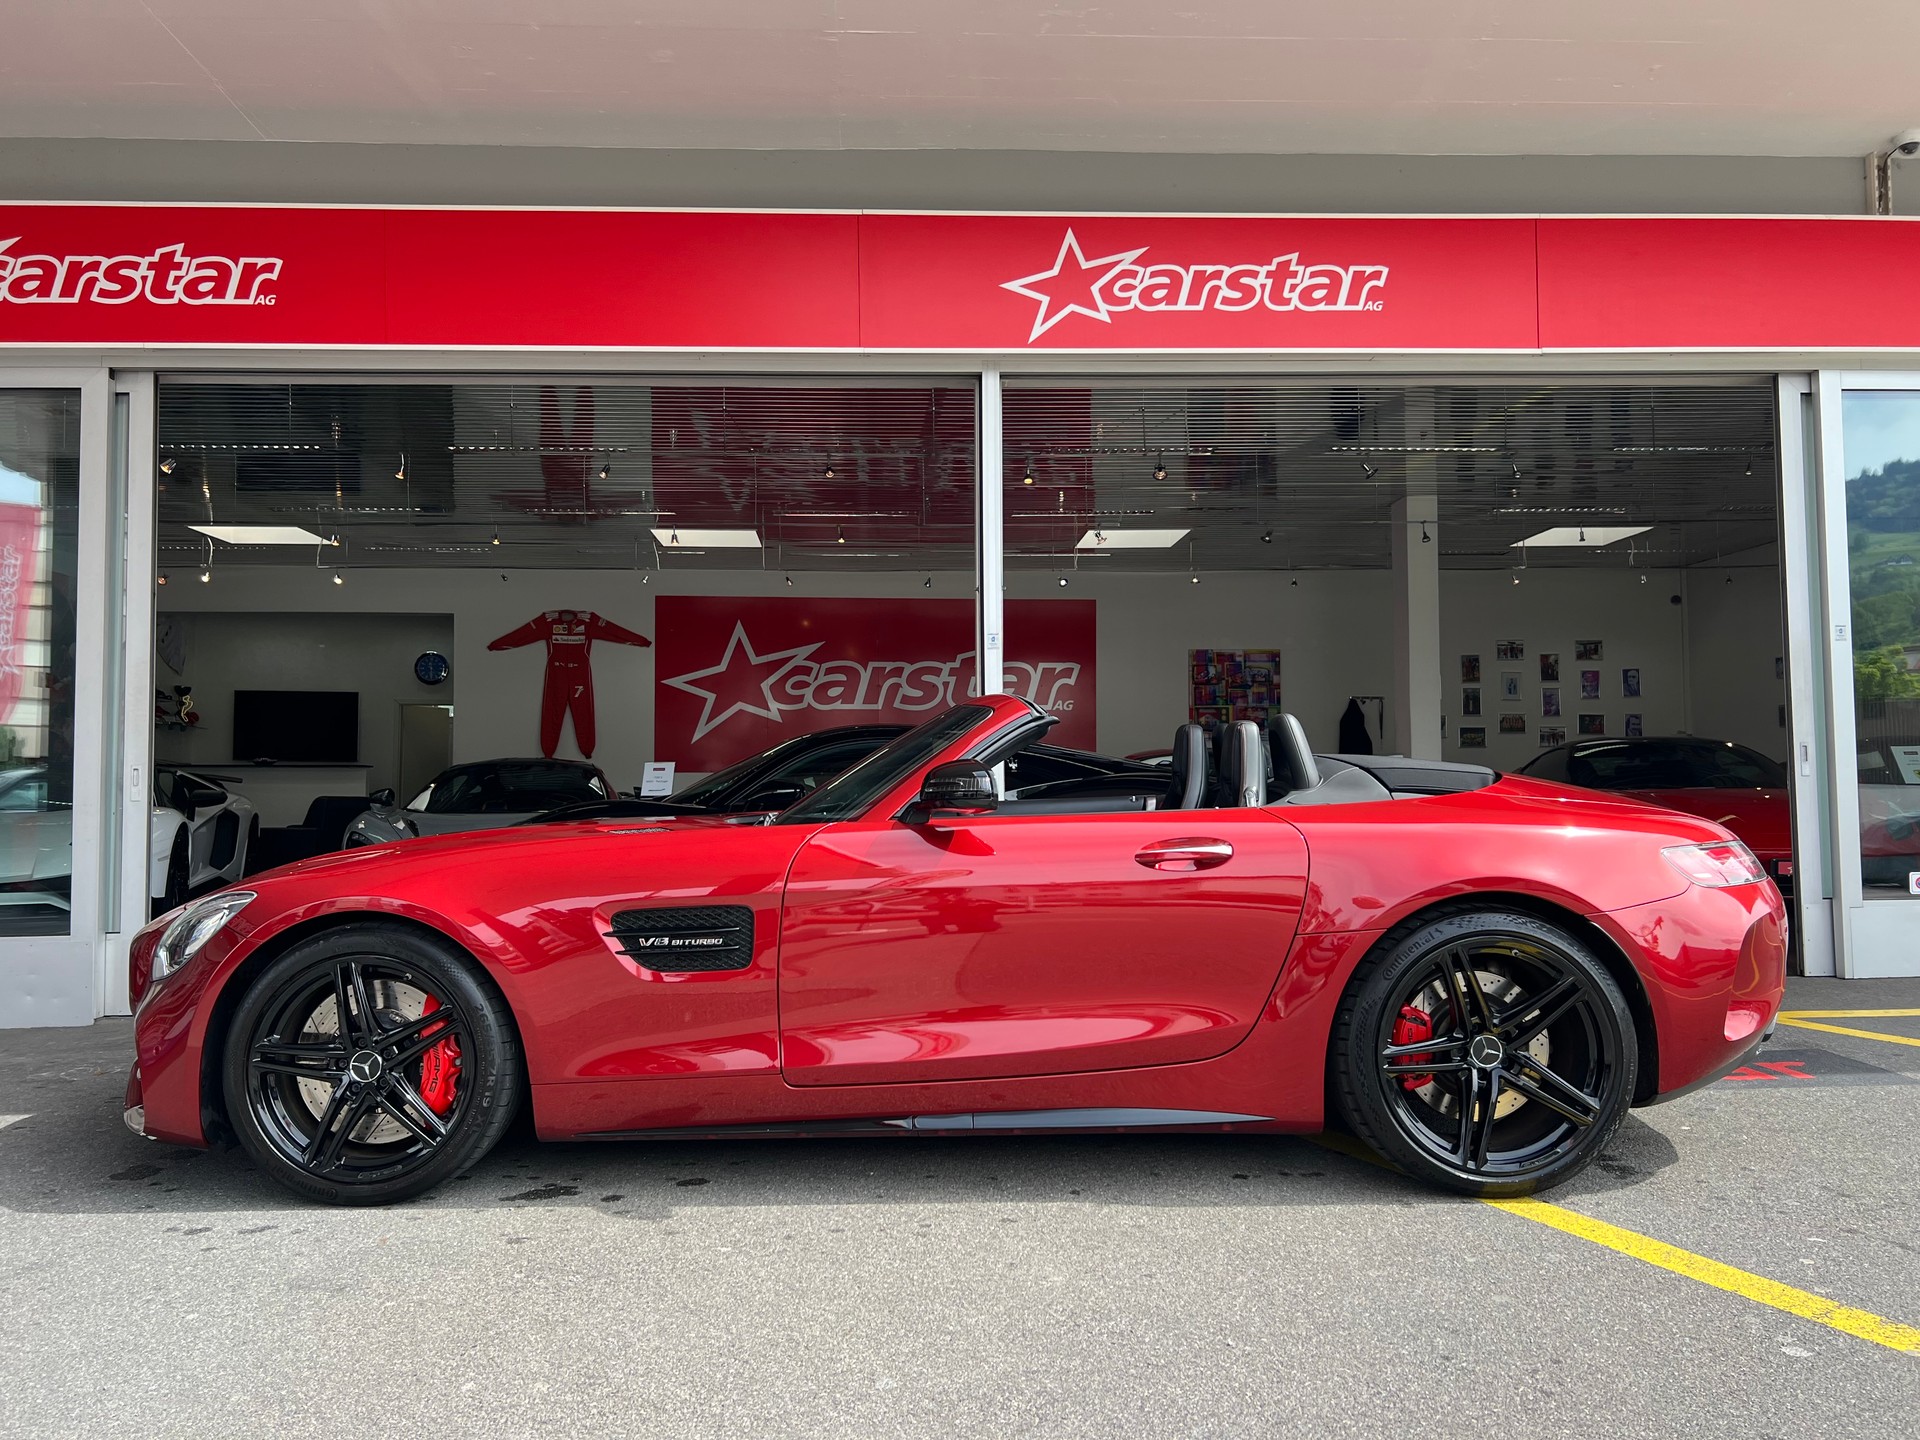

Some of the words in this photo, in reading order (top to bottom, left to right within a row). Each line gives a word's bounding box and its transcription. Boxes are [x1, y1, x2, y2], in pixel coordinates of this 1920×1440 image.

[1098, 252, 1389, 311] carstar
[1363, 300, 1384, 311] AG
[254, 295, 276, 306] AG
[574, 685, 584, 698] 7
[1053, 700, 1074, 711] AG
[639, 937, 669, 947] V8
[671, 938, 723, 946] BITURBO
